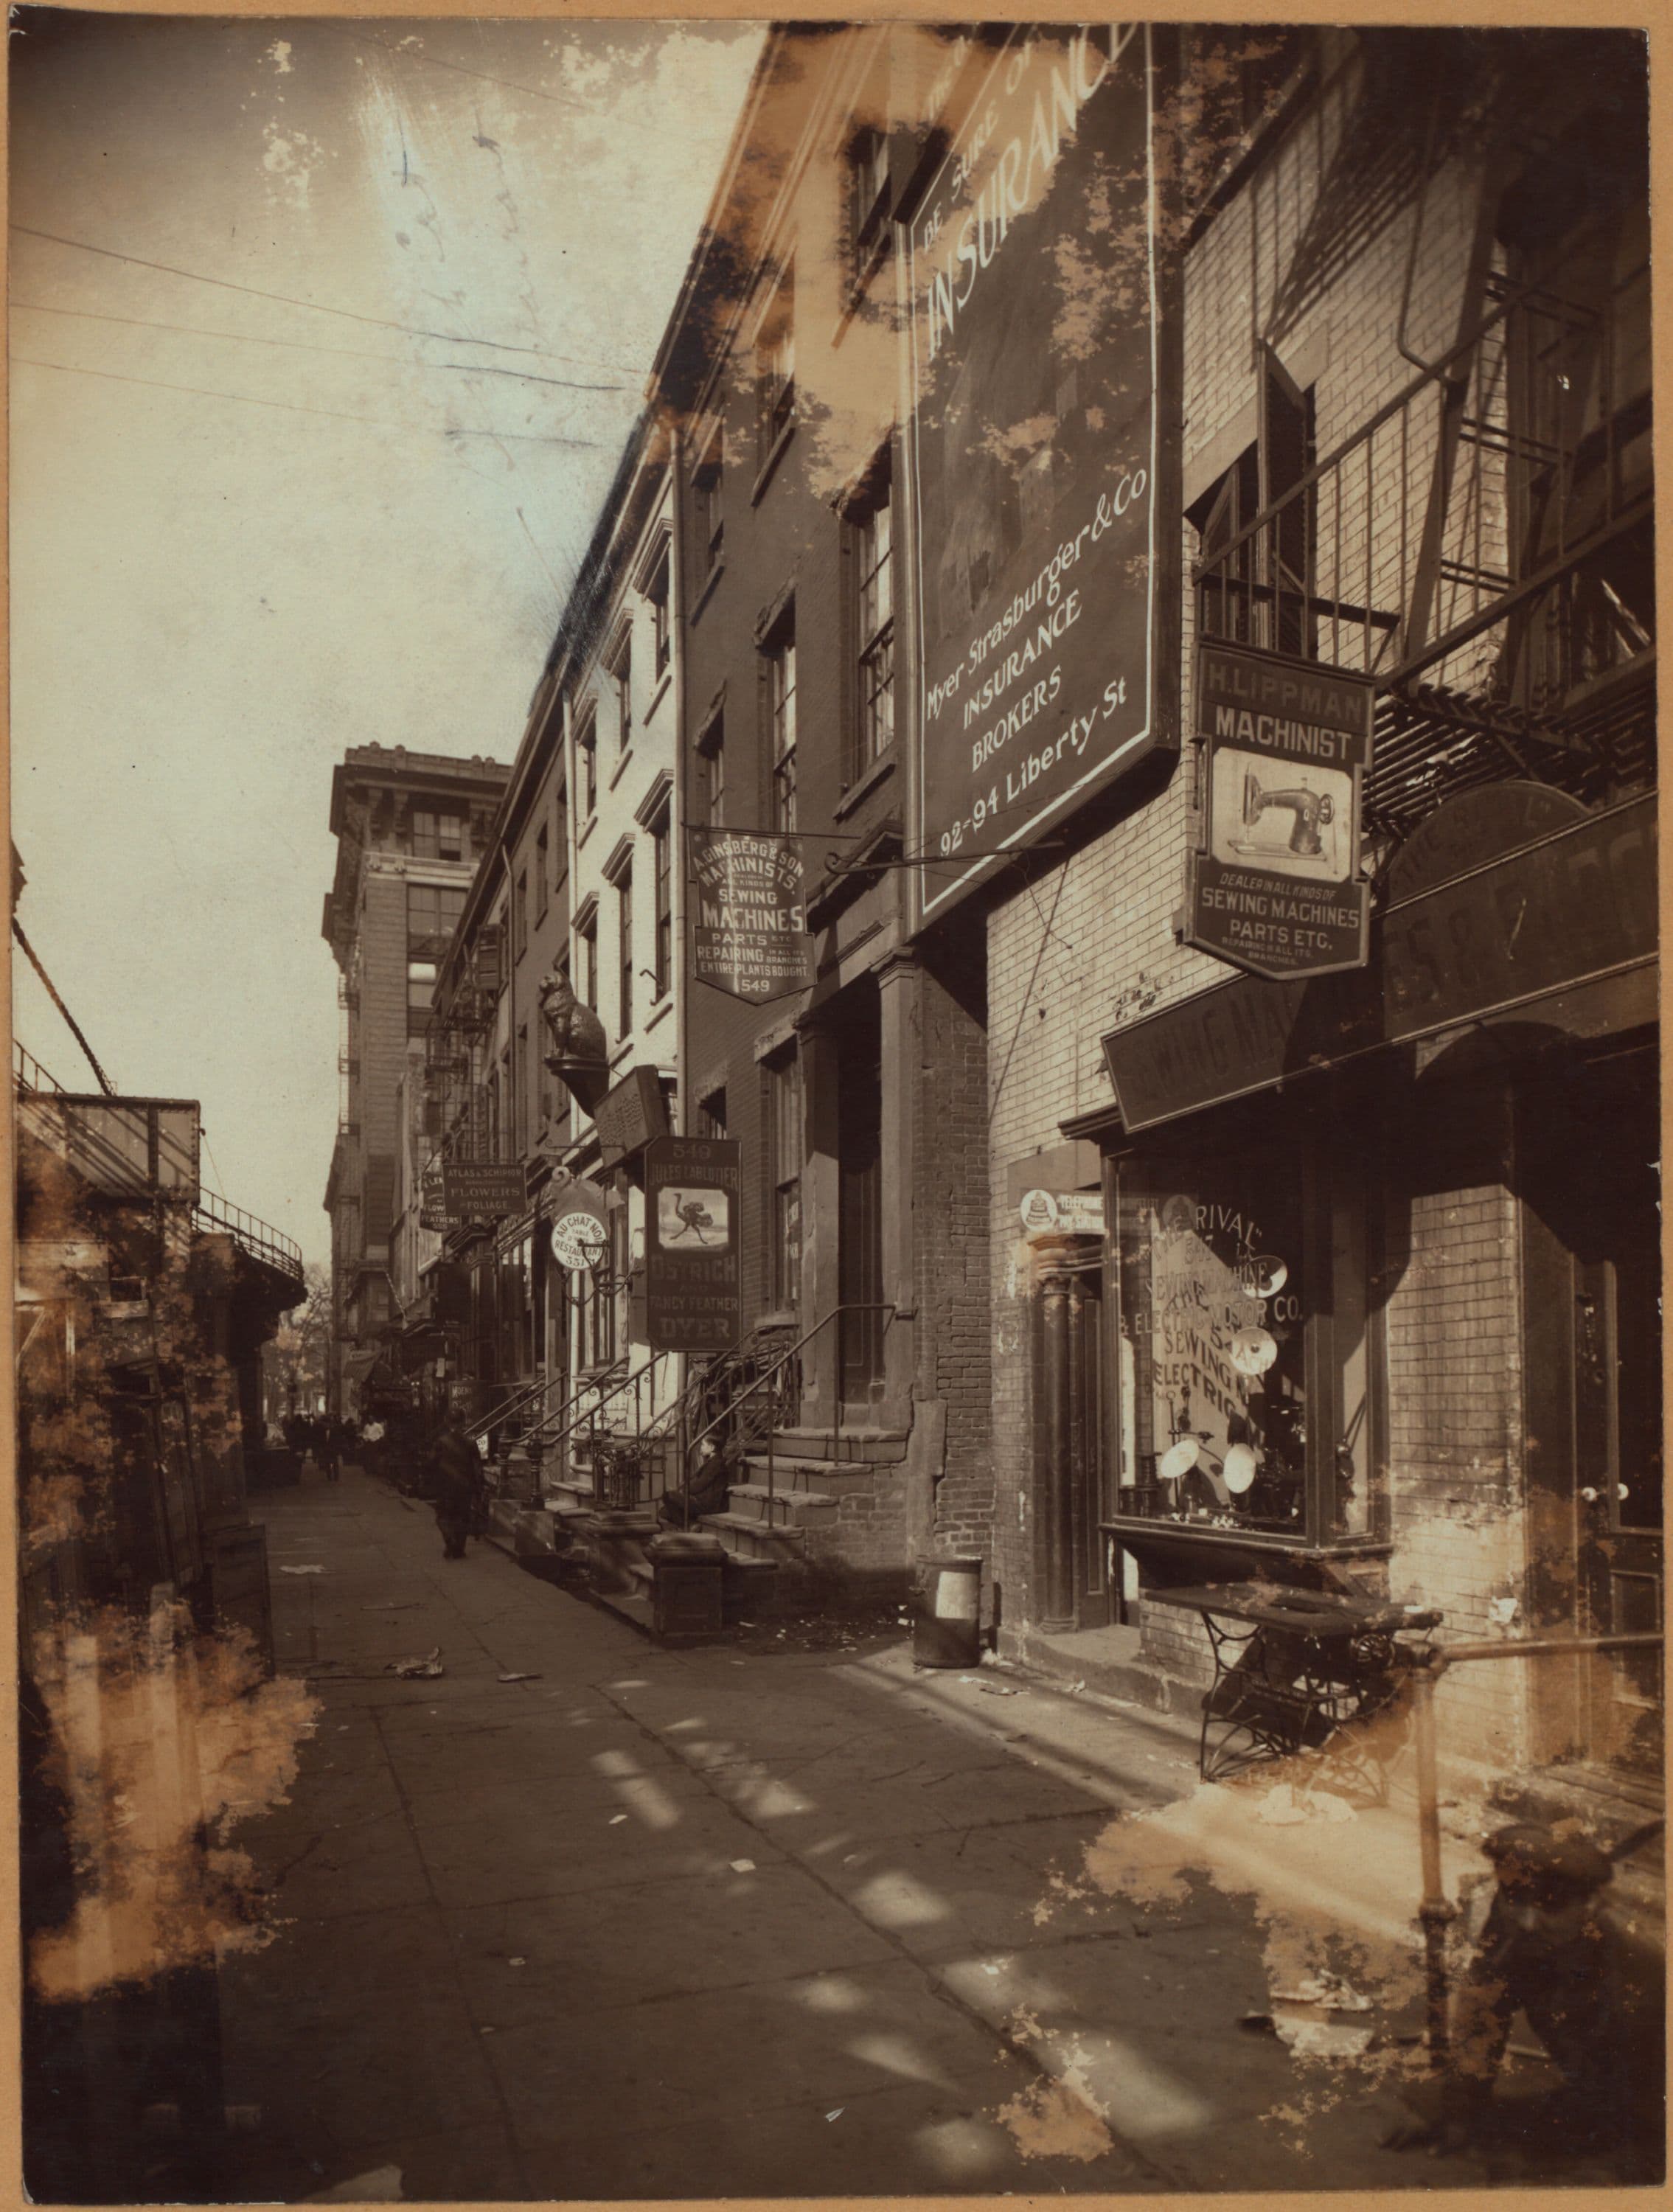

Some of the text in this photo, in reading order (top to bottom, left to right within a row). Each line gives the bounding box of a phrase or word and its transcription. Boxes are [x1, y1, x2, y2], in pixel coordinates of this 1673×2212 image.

[923, 204, 944, 254] BE
[951, 100, 1000, 204] SURE
[927, 655, 965, 722] Myer
[967, 523, 1093, 675] Strasburger
[1113, 467, 1148, 517] Co
[962, 588, 1083, 731] INSURANCE
[971, 665, 1063, 773] BROKERS
[1006, 706, 1099, 803] Liberty
[1102, 676, 1127, 720] St
[1215, 704, 1352, 759] MACHINIST
[769, 846, 778, 861] &
[779, 852, 804, 878] SON
[740, 880, 764, 888] KINDS
[1220, 872, 1263, 890] DEALER
[1273, 882, 1291, 897] ALL
[1292, 884, 1323, 900] KINDS
[719, 888, 779, 905] SEWING
[702, 900, 804, 933] MACHINES
[1203, 887, 1360, 929] SEWING MACHINES
[712, 933, 768, 946] PARTS
[1222, 936, 1265, 952] REPAIRING
[1275, 944, 1293, 956] ALL
[1230, 919, 1334, 951] PARTS ETC.
[697, 945, 764, 963] REPAIRING
[766, 956, 808, 965] BRANCHES
[700, 961, 734, 975] ENTIRE
[735, 963, 771, 976] PLANTS
[741, 979, 771, 992] 549
[672, 1144, 713, 1161] 549
[448, 1169, 475, 1178] ATLAS
[451, 1186, 521, 1198] FLOWERS
[557, 1223, 568, 1238] AU
[567, 1216, 591, 1228] CHAT
[554, 1239, 602, 1257] RESTAUANT
[651, 1253, 737, 1283] OSTRICH
[650, 1296, 739, 1311] FANCY FEATHER
[1273, 1295, 1304, 1323] CO.
[658, 1317, 731, 1340] DYER
